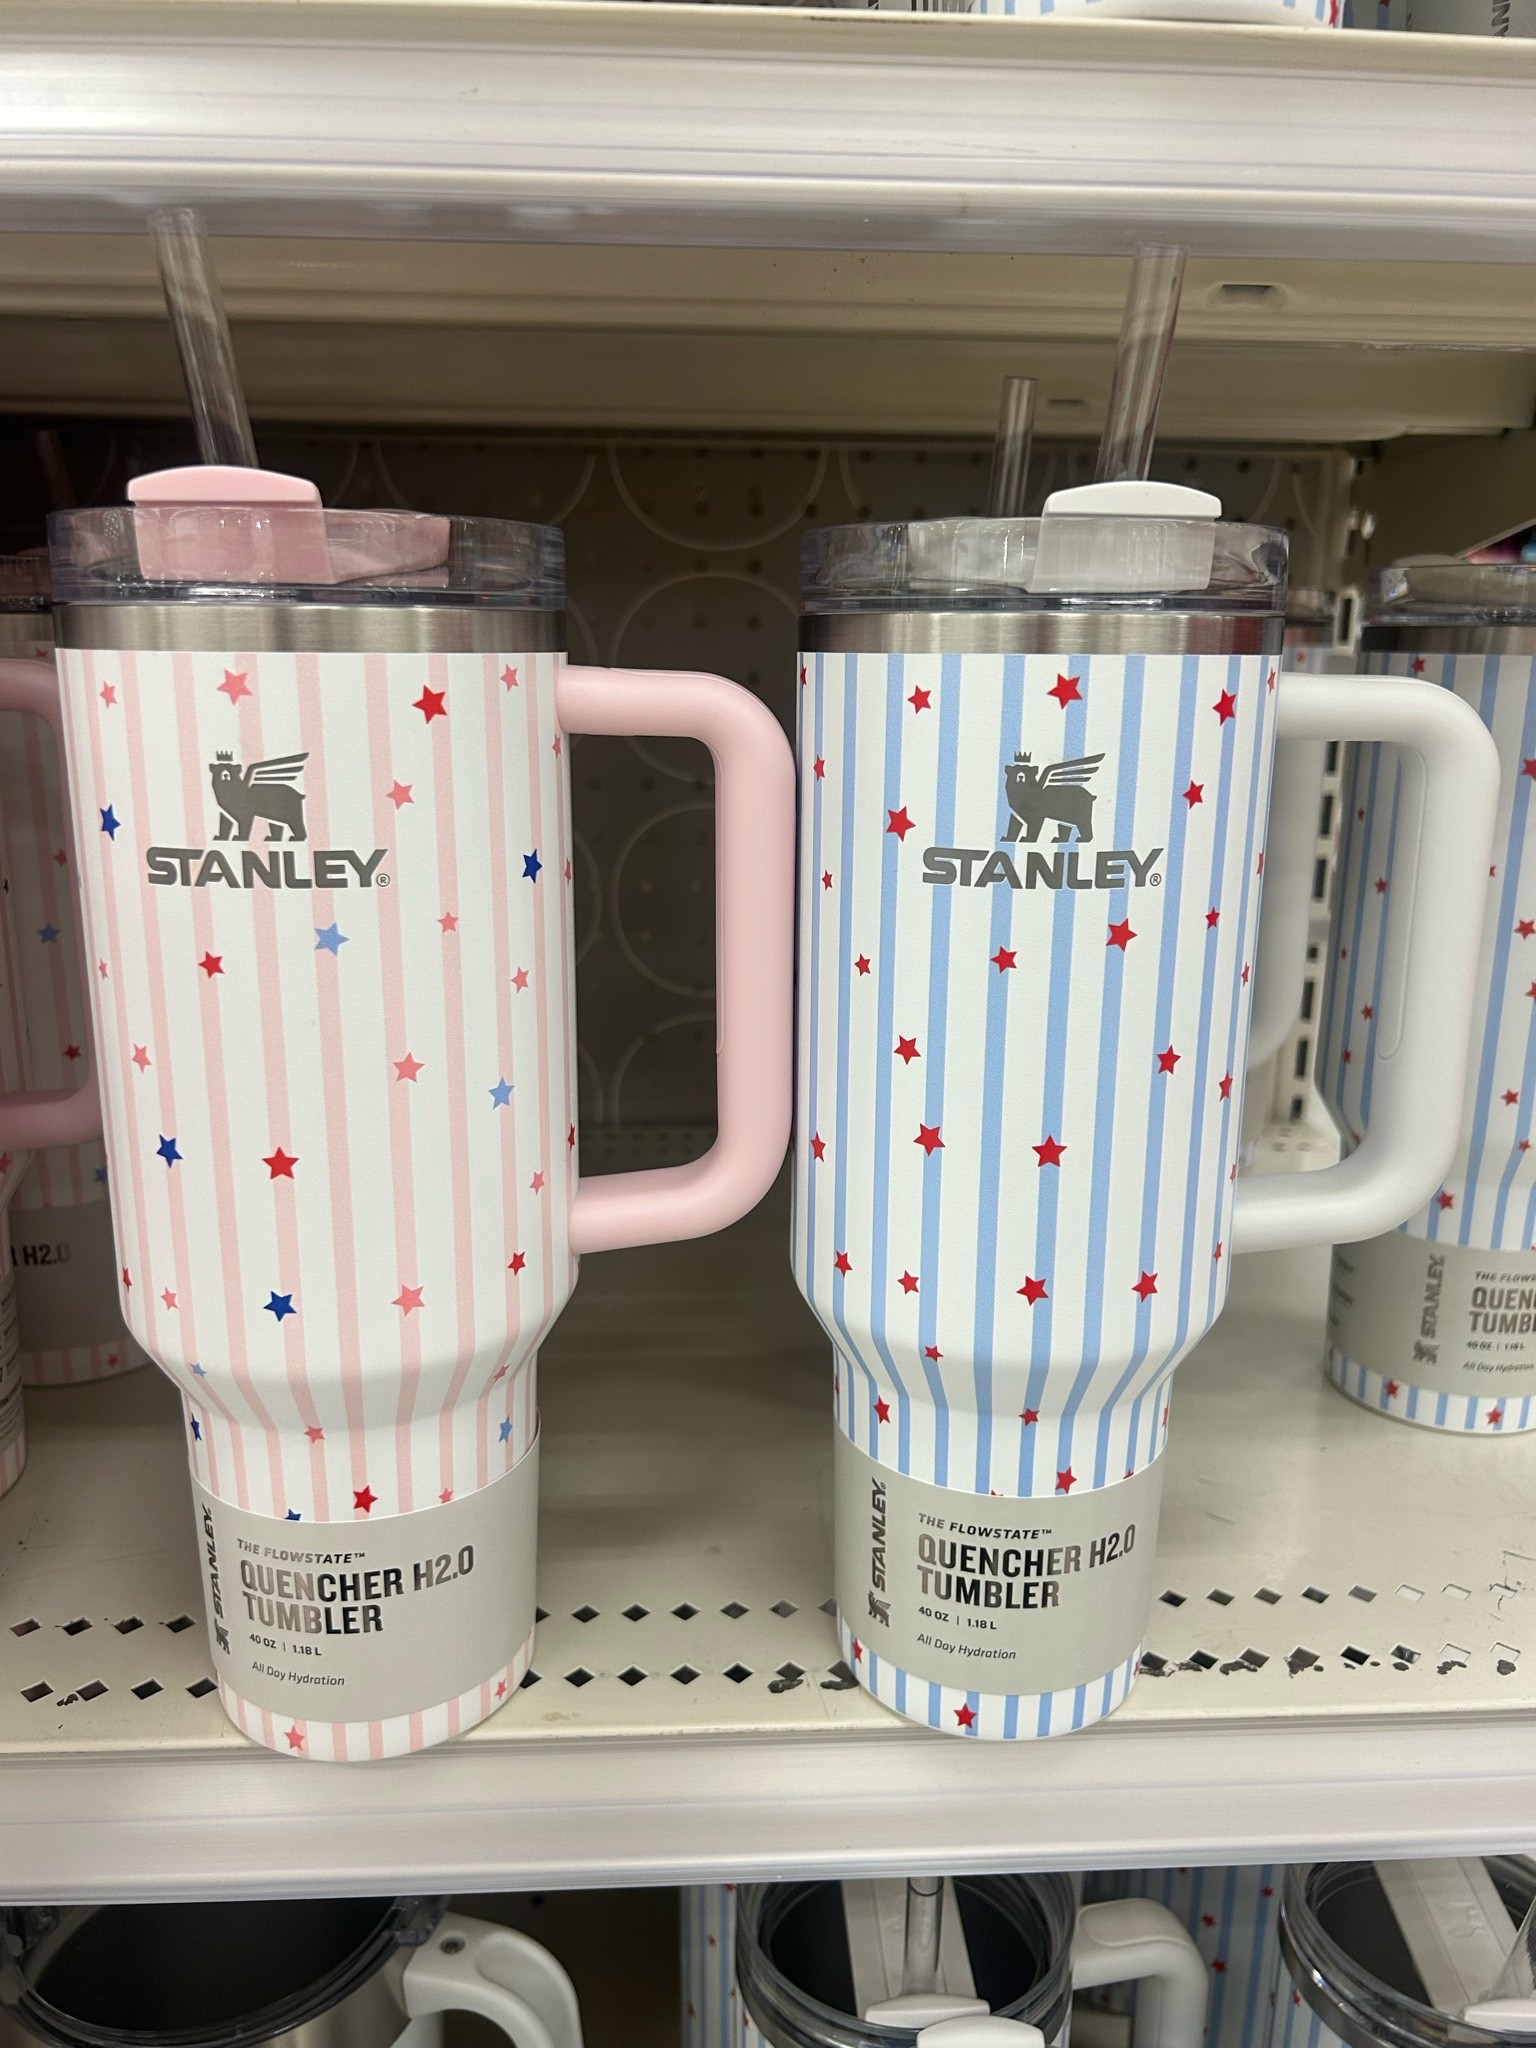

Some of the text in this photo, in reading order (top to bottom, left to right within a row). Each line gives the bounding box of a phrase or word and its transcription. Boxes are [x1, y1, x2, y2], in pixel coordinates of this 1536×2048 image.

[23, 1243, 72, 1267] H2.0
[1471, 1286, 1536, 1310] QUEN
[1495, 1363, 1535, 1373] Hydration
[918, 1512, 946, 1529] THE
[237, 1538, 260, 1554] THE
[918, 1523, 1136, 1578] QUENCHER H2.0
[240, 1544, 475, 1602] QUENCHER H2.0
[917, 1564, 1060, 1609] TUMBLER
[242, 1590, 383, 1634] TUMBLER
[918, 1606, 932, 1617] 40
[934, 1610, 949, 1622] OZ
[967, 1618, 987, 1629] 1.18
[990, 1621, 997, 1630] L
[249, 1633, 261, 1644] 40
[263, 1637, 277, 1649] OZ
[292, 1644, 312, 1655] 1.18
[315, 1647, 322, 1656] L
[917, 1633, 1016, 1660] All Day Hydration
[252, 1661, 345, 1686] All Day Hydration
